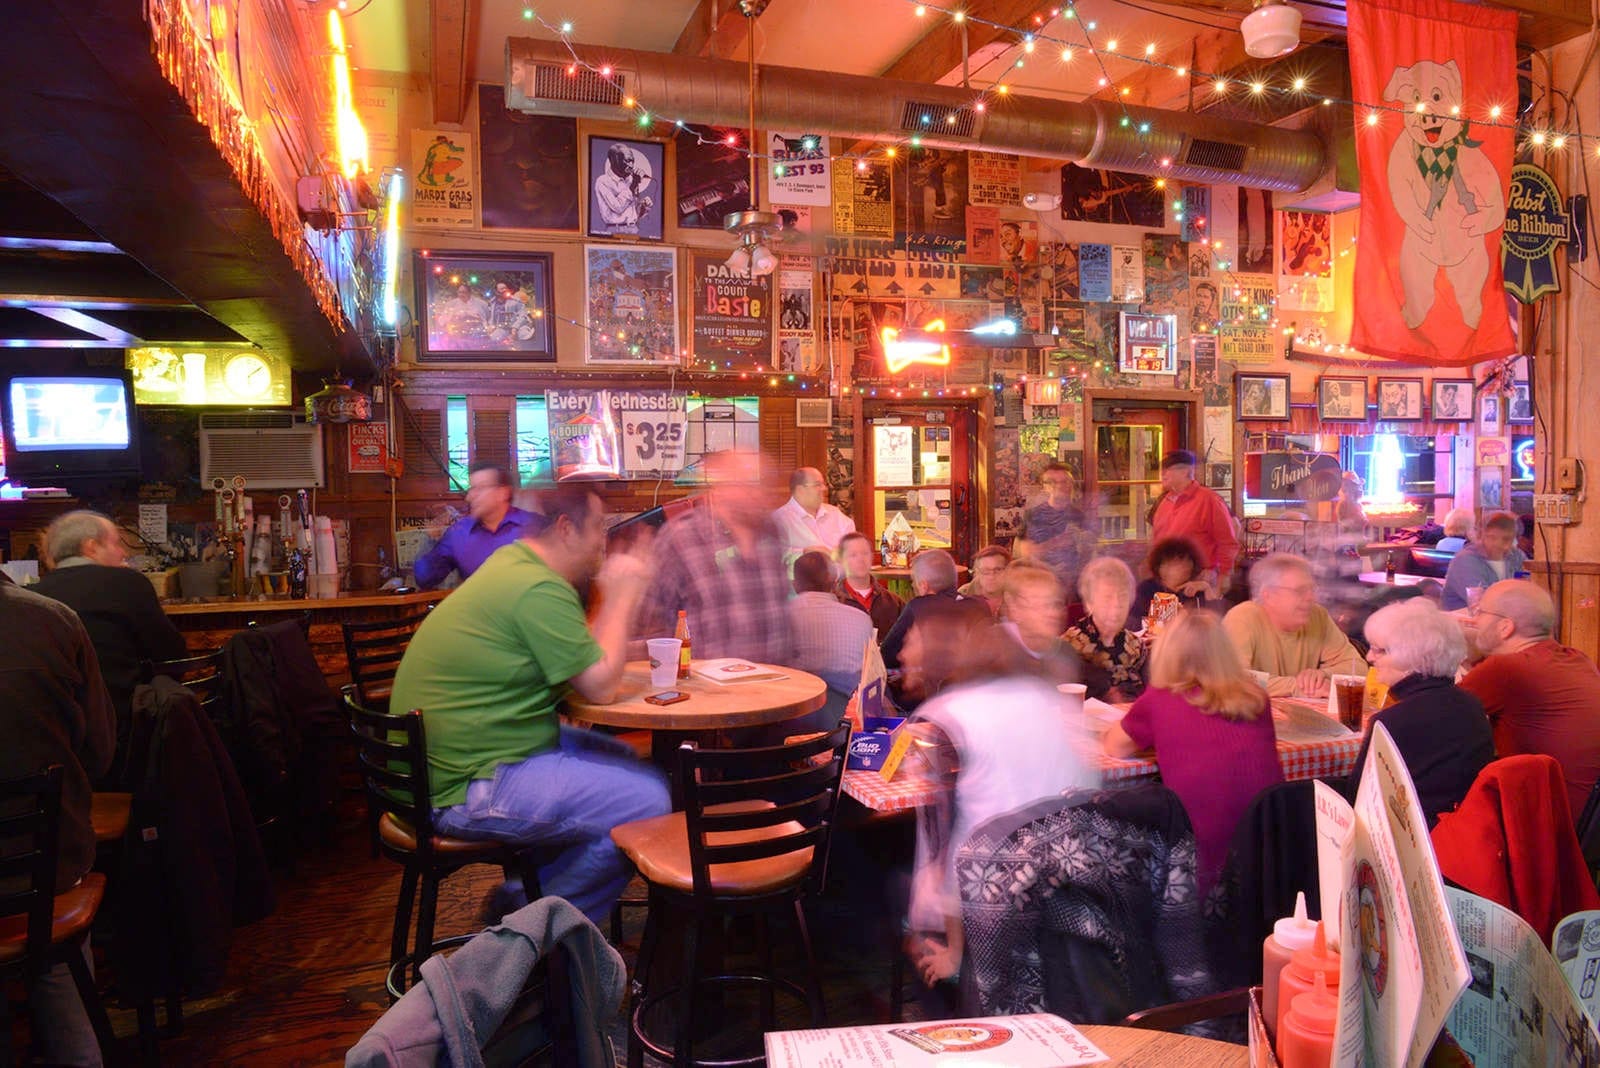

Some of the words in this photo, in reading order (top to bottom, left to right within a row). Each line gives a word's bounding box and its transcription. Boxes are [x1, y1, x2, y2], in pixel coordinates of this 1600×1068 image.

[810, 163, 824, 175] 93
[415, 189, 446, 201] MARDI
[449, 191, 473, 202] GRAS
[979, 190, 996, 198] EDDIE
[1000, 191, 1020, 200] TAYLOR
[1507, 181, 1547, 212] Pabst
[1504, 218, 1518, 232] ue
[1520, 213, 1566, 238] Ribbon
[1517, 235, 1539, 243] BEER
[717, 285, 748, 296] COUNT
[1253, 287, 1274, 304] KING
[707, 284, 761, 318] Basie
[1222, 305, 1244, 319] OTIS
[1243, 329, 1260, 338] NOV.
[549, 391, 593, 415] Every
[597, 391, 686, 412] Wednesday
[1271, 456, 1311, 490] Thank
